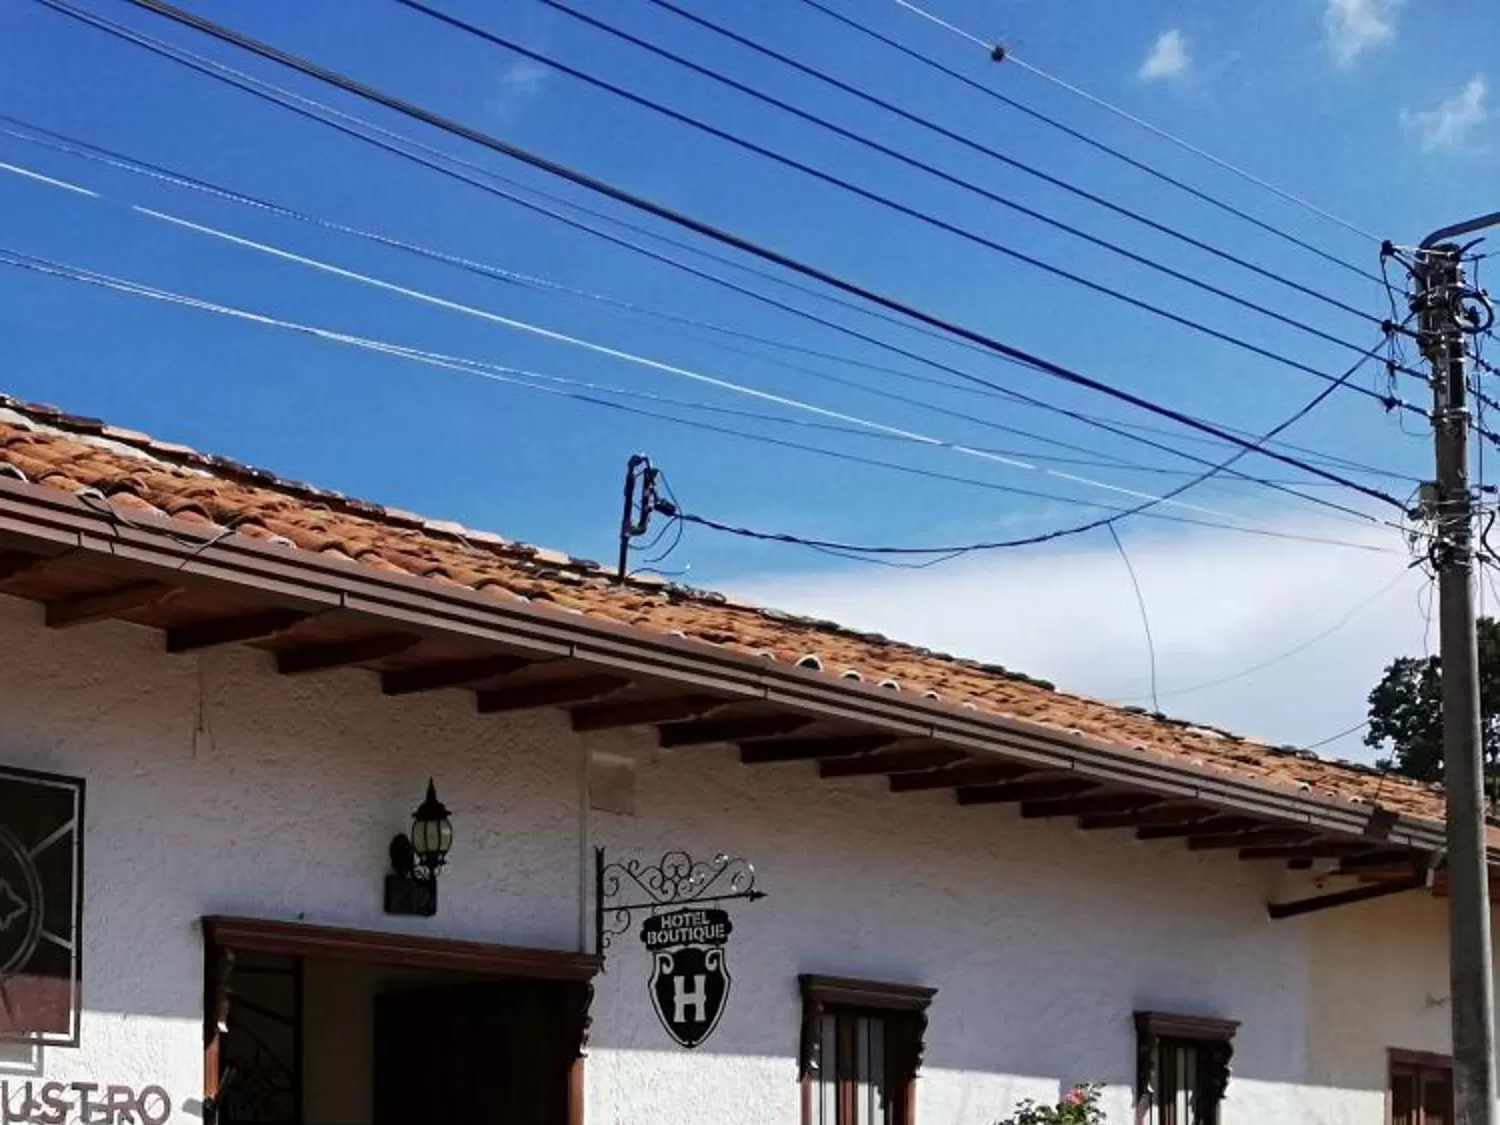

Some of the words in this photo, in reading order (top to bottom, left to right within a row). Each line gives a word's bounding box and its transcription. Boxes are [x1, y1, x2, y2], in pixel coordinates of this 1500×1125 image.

[661, 911, 710, 929] HOTEL
[647, 923, 725, 944] BOUTIQUE
[673, 975, 706, 1023] H
